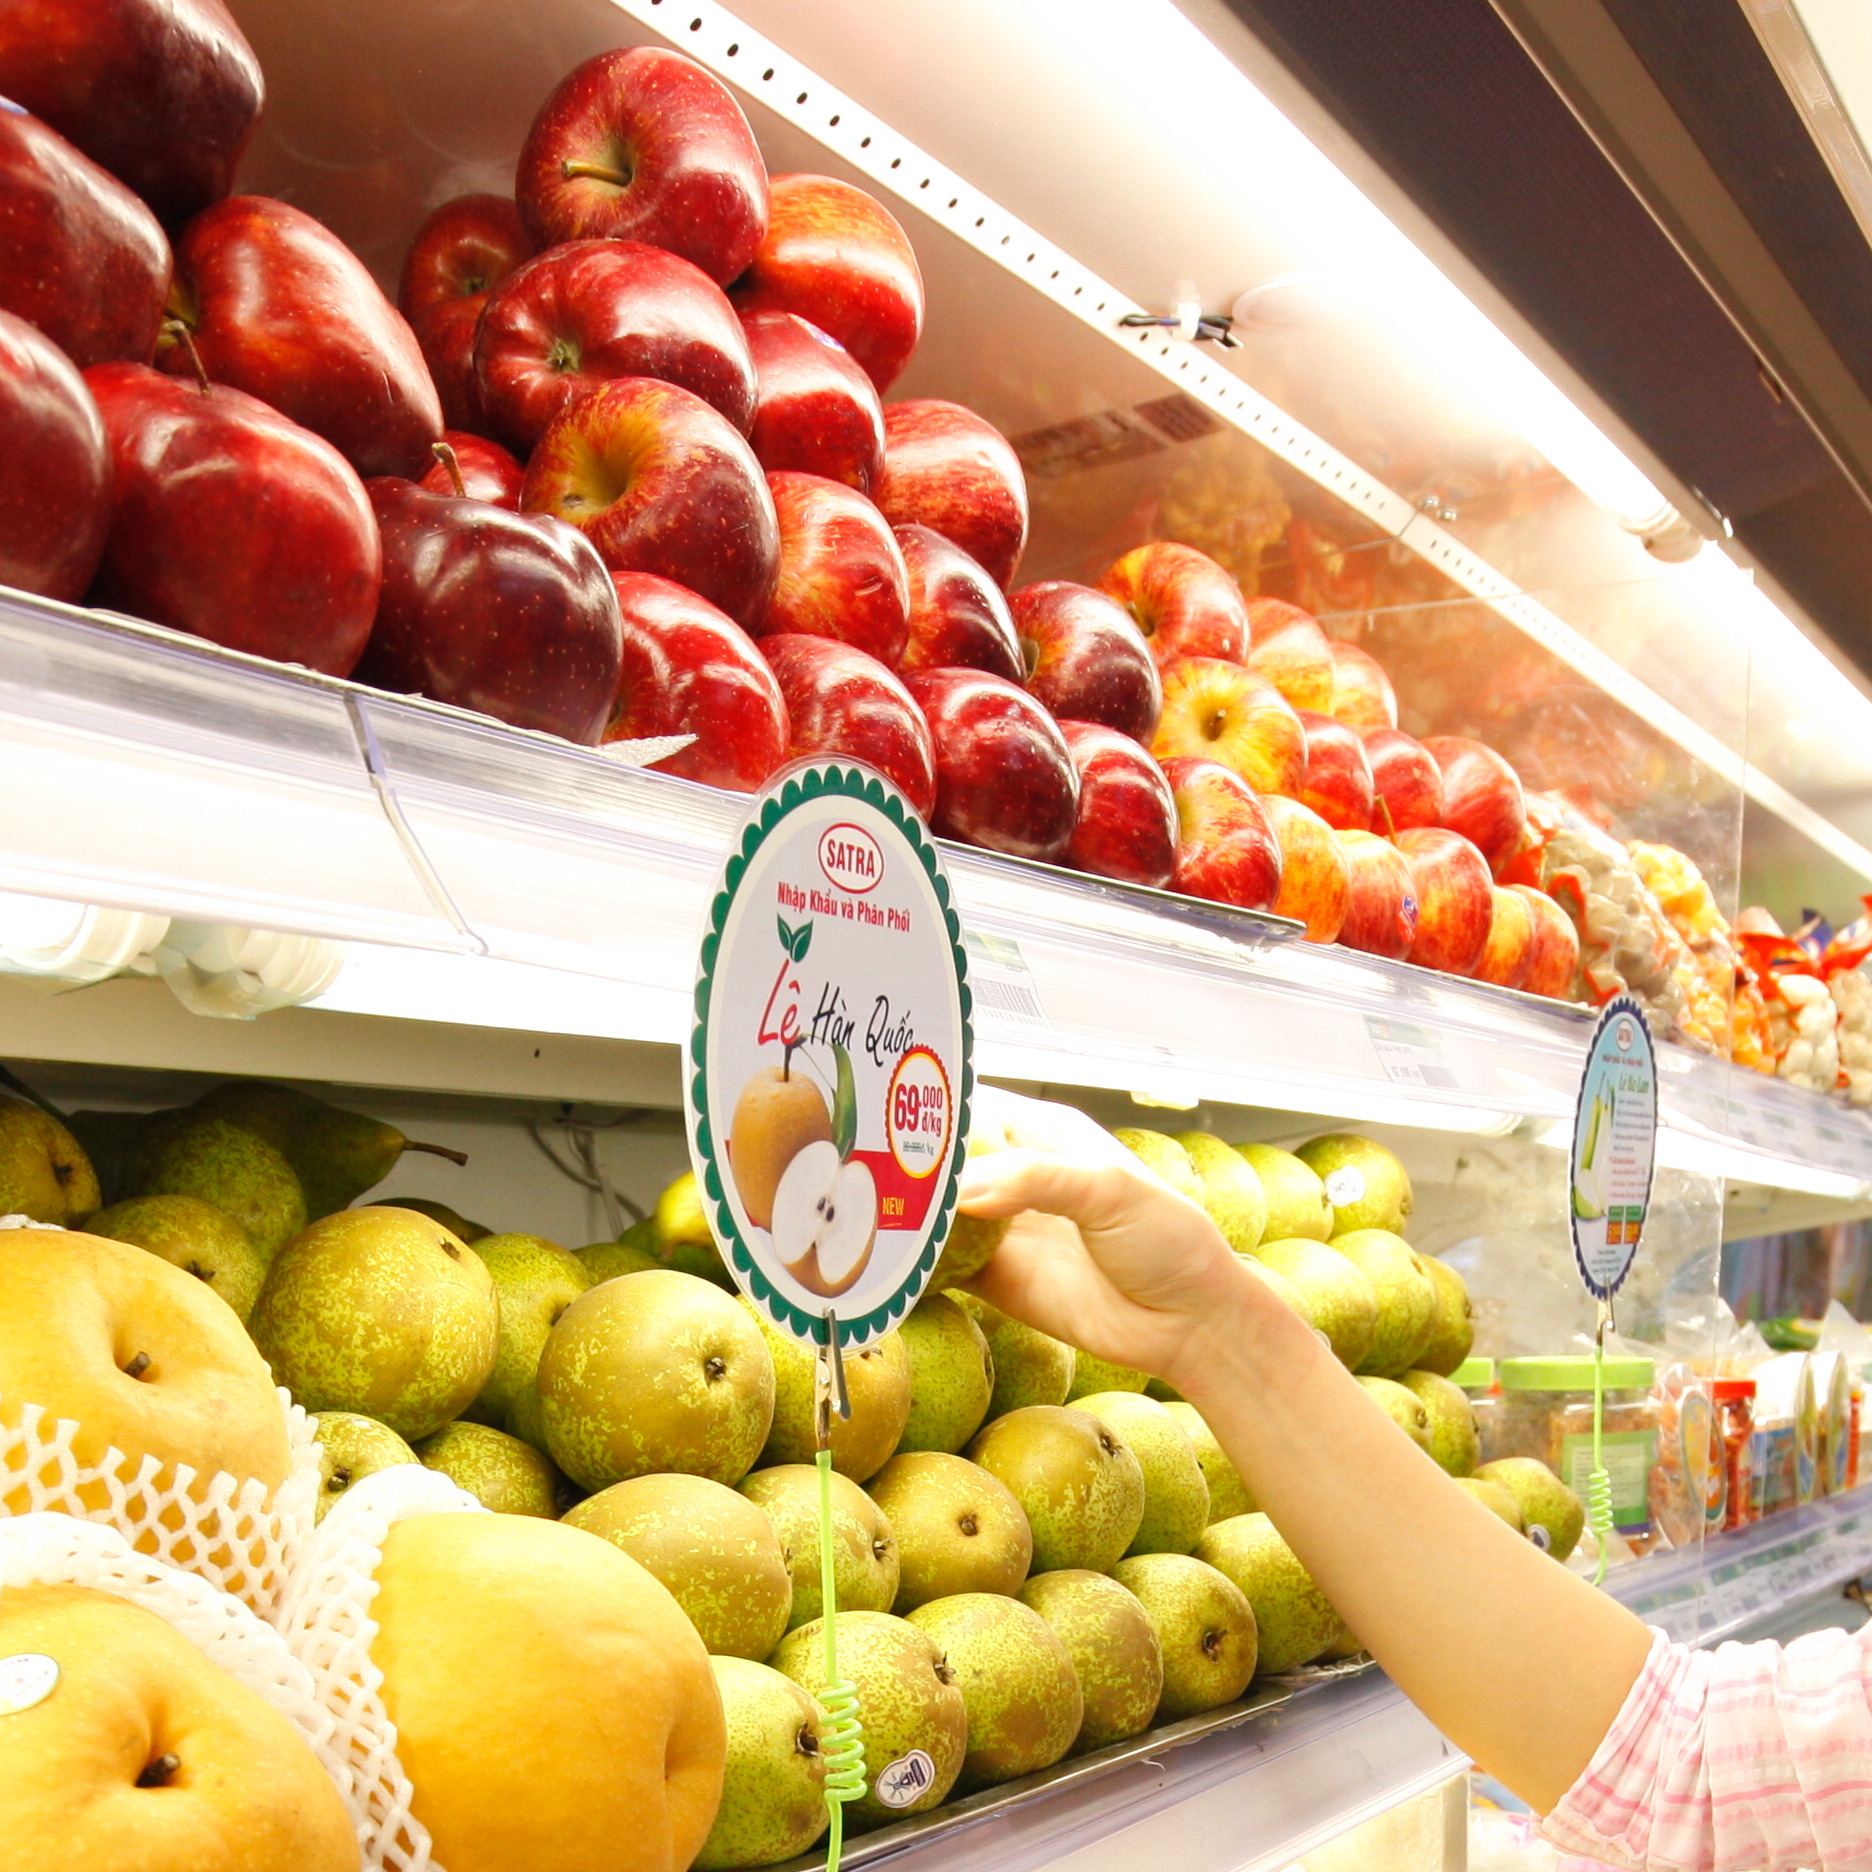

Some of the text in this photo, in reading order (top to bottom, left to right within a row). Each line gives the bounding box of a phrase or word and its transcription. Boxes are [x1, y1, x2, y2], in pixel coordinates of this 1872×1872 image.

[828, 840, 876, 879] SATRA
[778, 881, 911, 932] Nhập Khẩu và Phân Phối
[757, 958, 914, 1068] Lê Hàn Quốc
[882, 1196, 905, 1218] NEW
